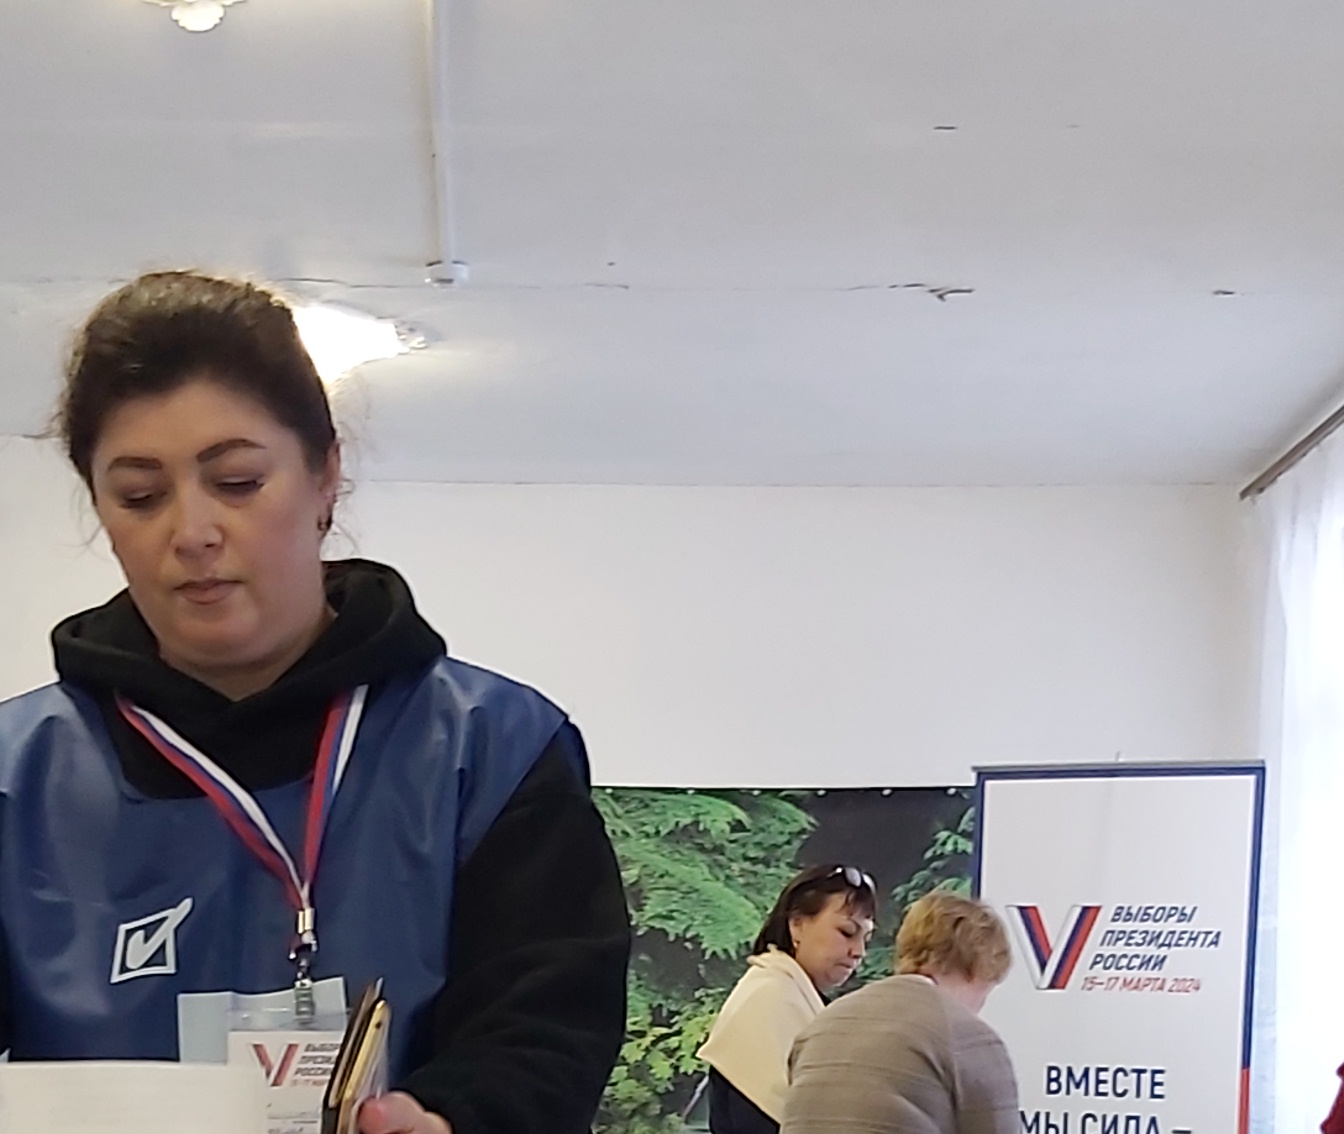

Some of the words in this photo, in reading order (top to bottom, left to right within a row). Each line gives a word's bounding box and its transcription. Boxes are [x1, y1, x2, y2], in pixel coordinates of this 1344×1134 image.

[1110, 905, 1198, 923] ВЫБОРЫ
[1099, 929, 1222, 950] ПРЕЗИДЕНТА
[1089, 953, 1168, 971] РОССИИ
[1120, 976, 1164, 992] МАРТА
[1167, 977, 1201, 993] 2024
[1045, 1065, 1166, 1099] ВМЕСТЕ
